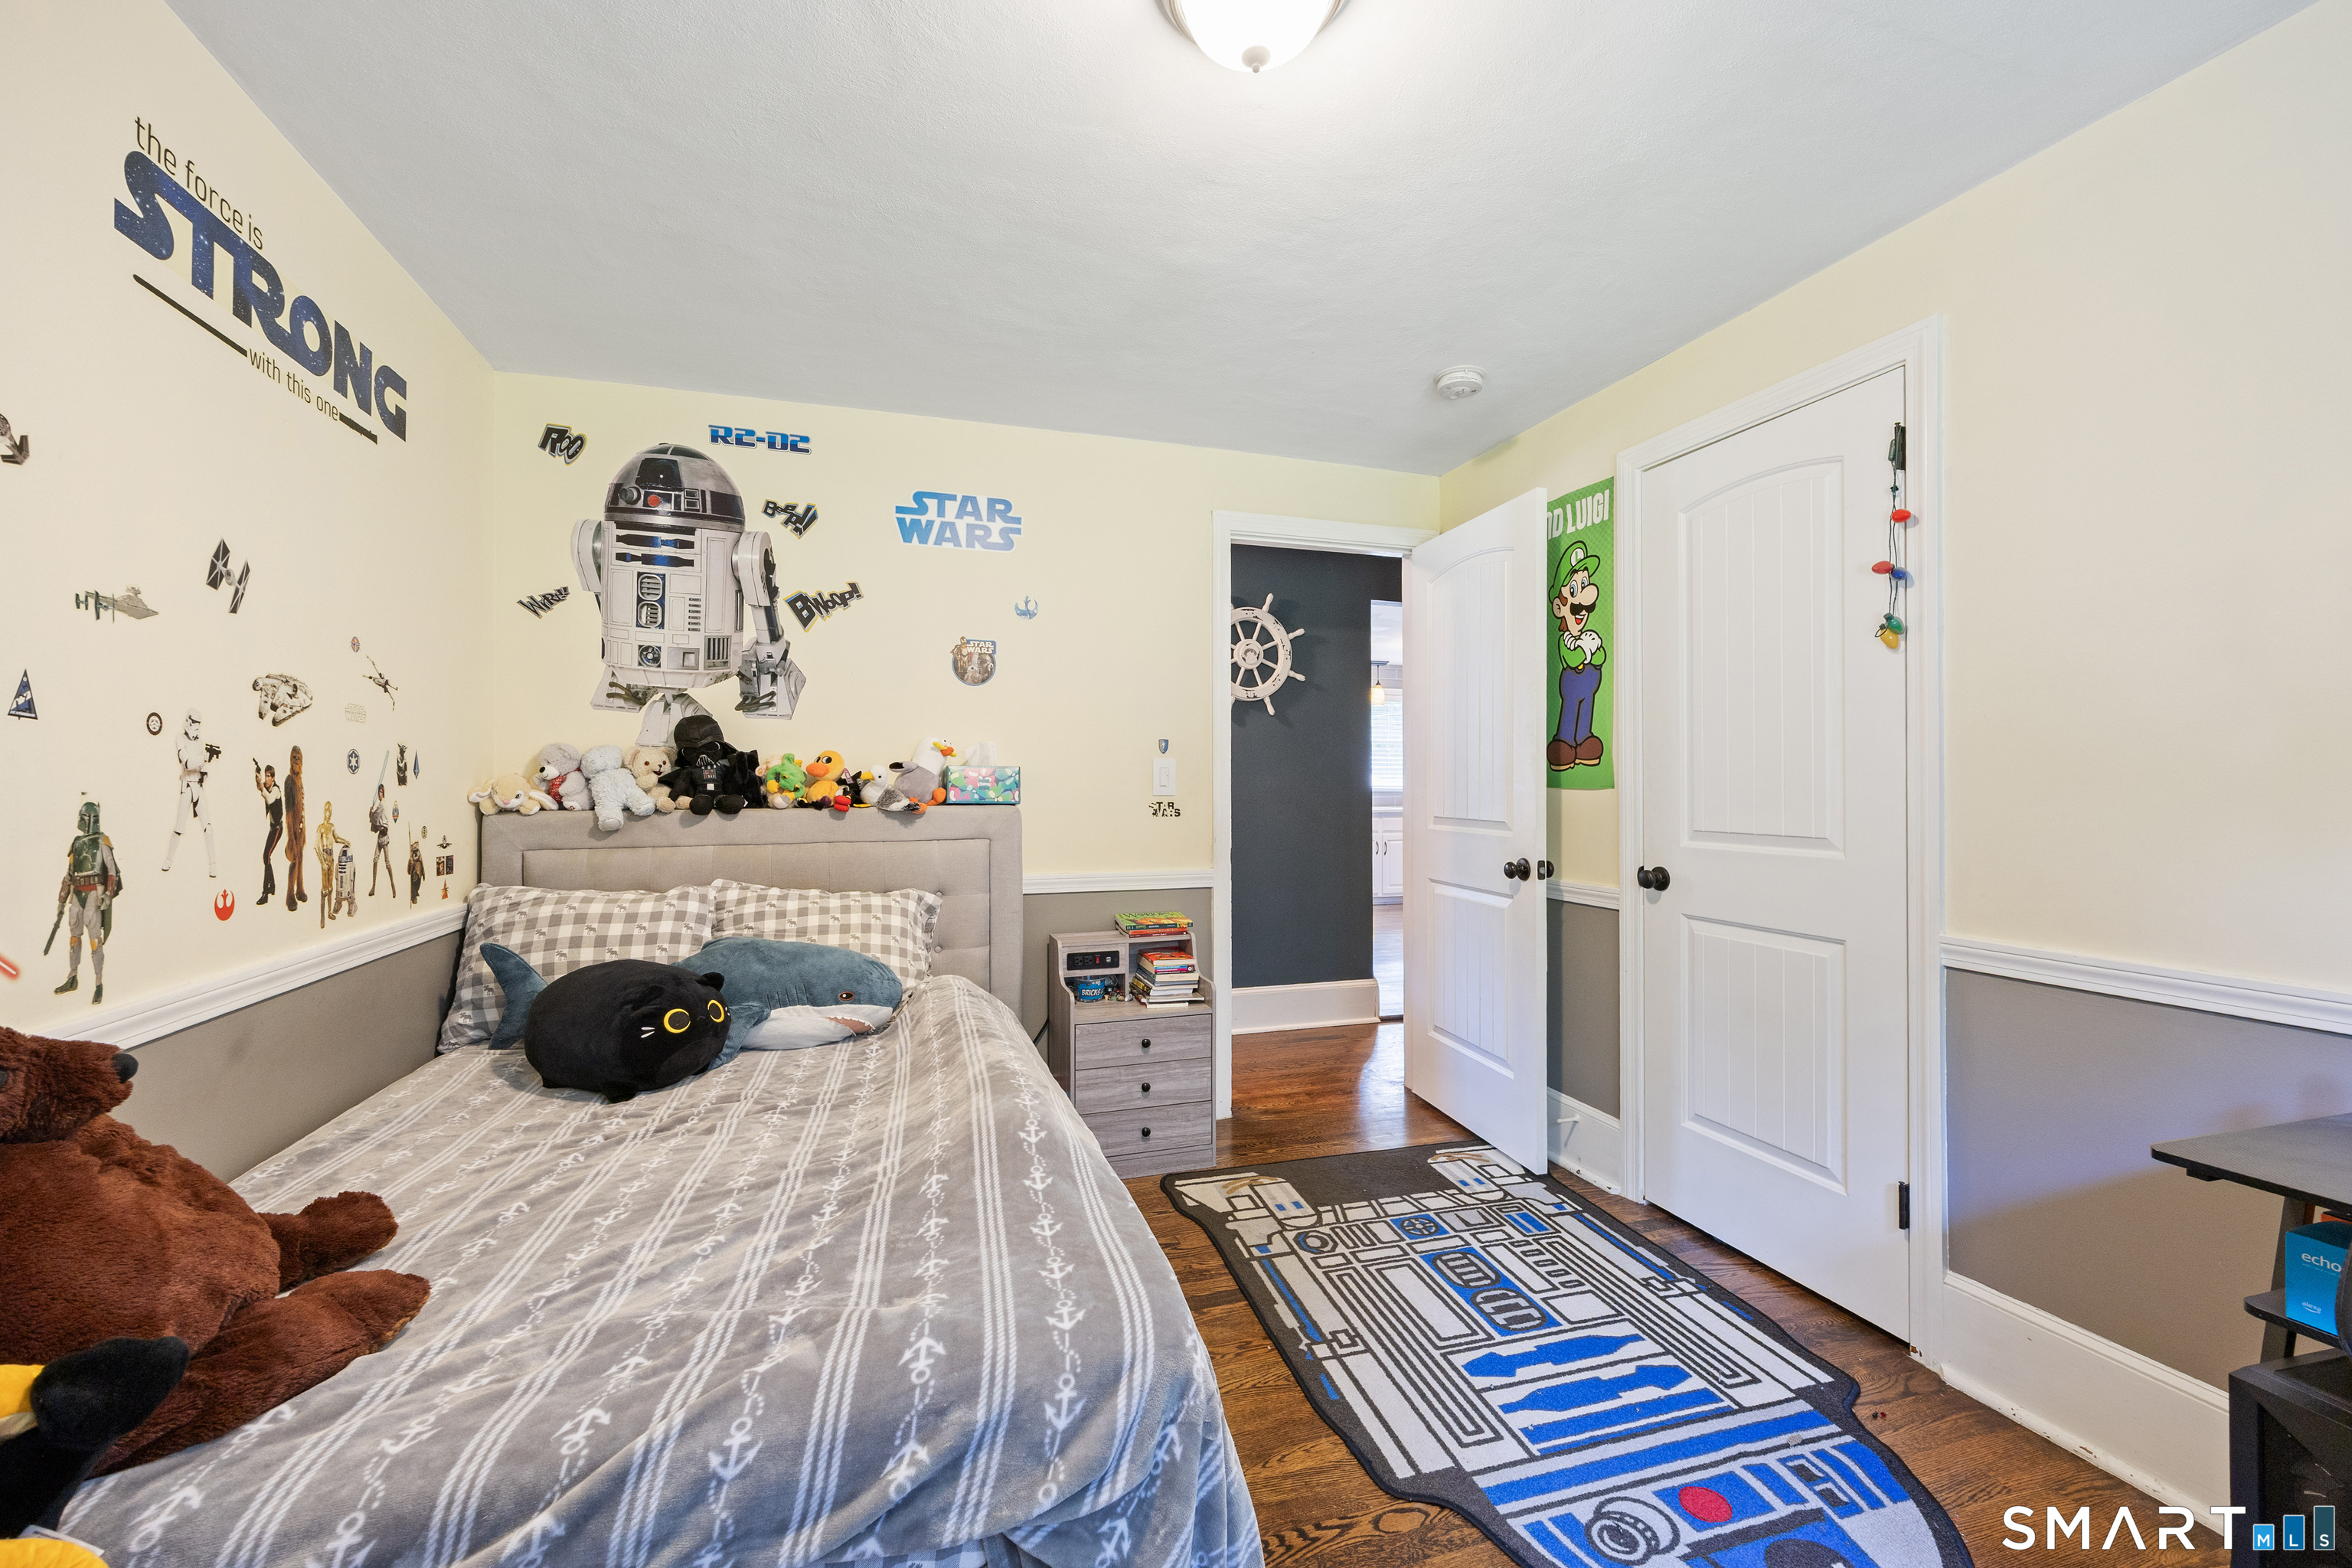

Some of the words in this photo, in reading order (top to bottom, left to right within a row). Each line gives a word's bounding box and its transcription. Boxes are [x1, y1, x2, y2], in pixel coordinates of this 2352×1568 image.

[135, 116, 177, 176] the
[185, 159, 243, 234] force
[248, 213, 263, 251] is
[114, 150, 407, 443] STRONG
[249, 348, 281, 384] with
[286, 371, 311, 403] this
[316, 395, 339, 421] one
[708, 424, 812, 454] R2-D2
[895, 490, 1022, 525] STAR
[1566, 488, 1609, 534] LUIGI
[896, 516, 1022, 551] WARS
[1148, 801, 1174, 812] STR
[2301, 1253, 2342, 1272] echo
